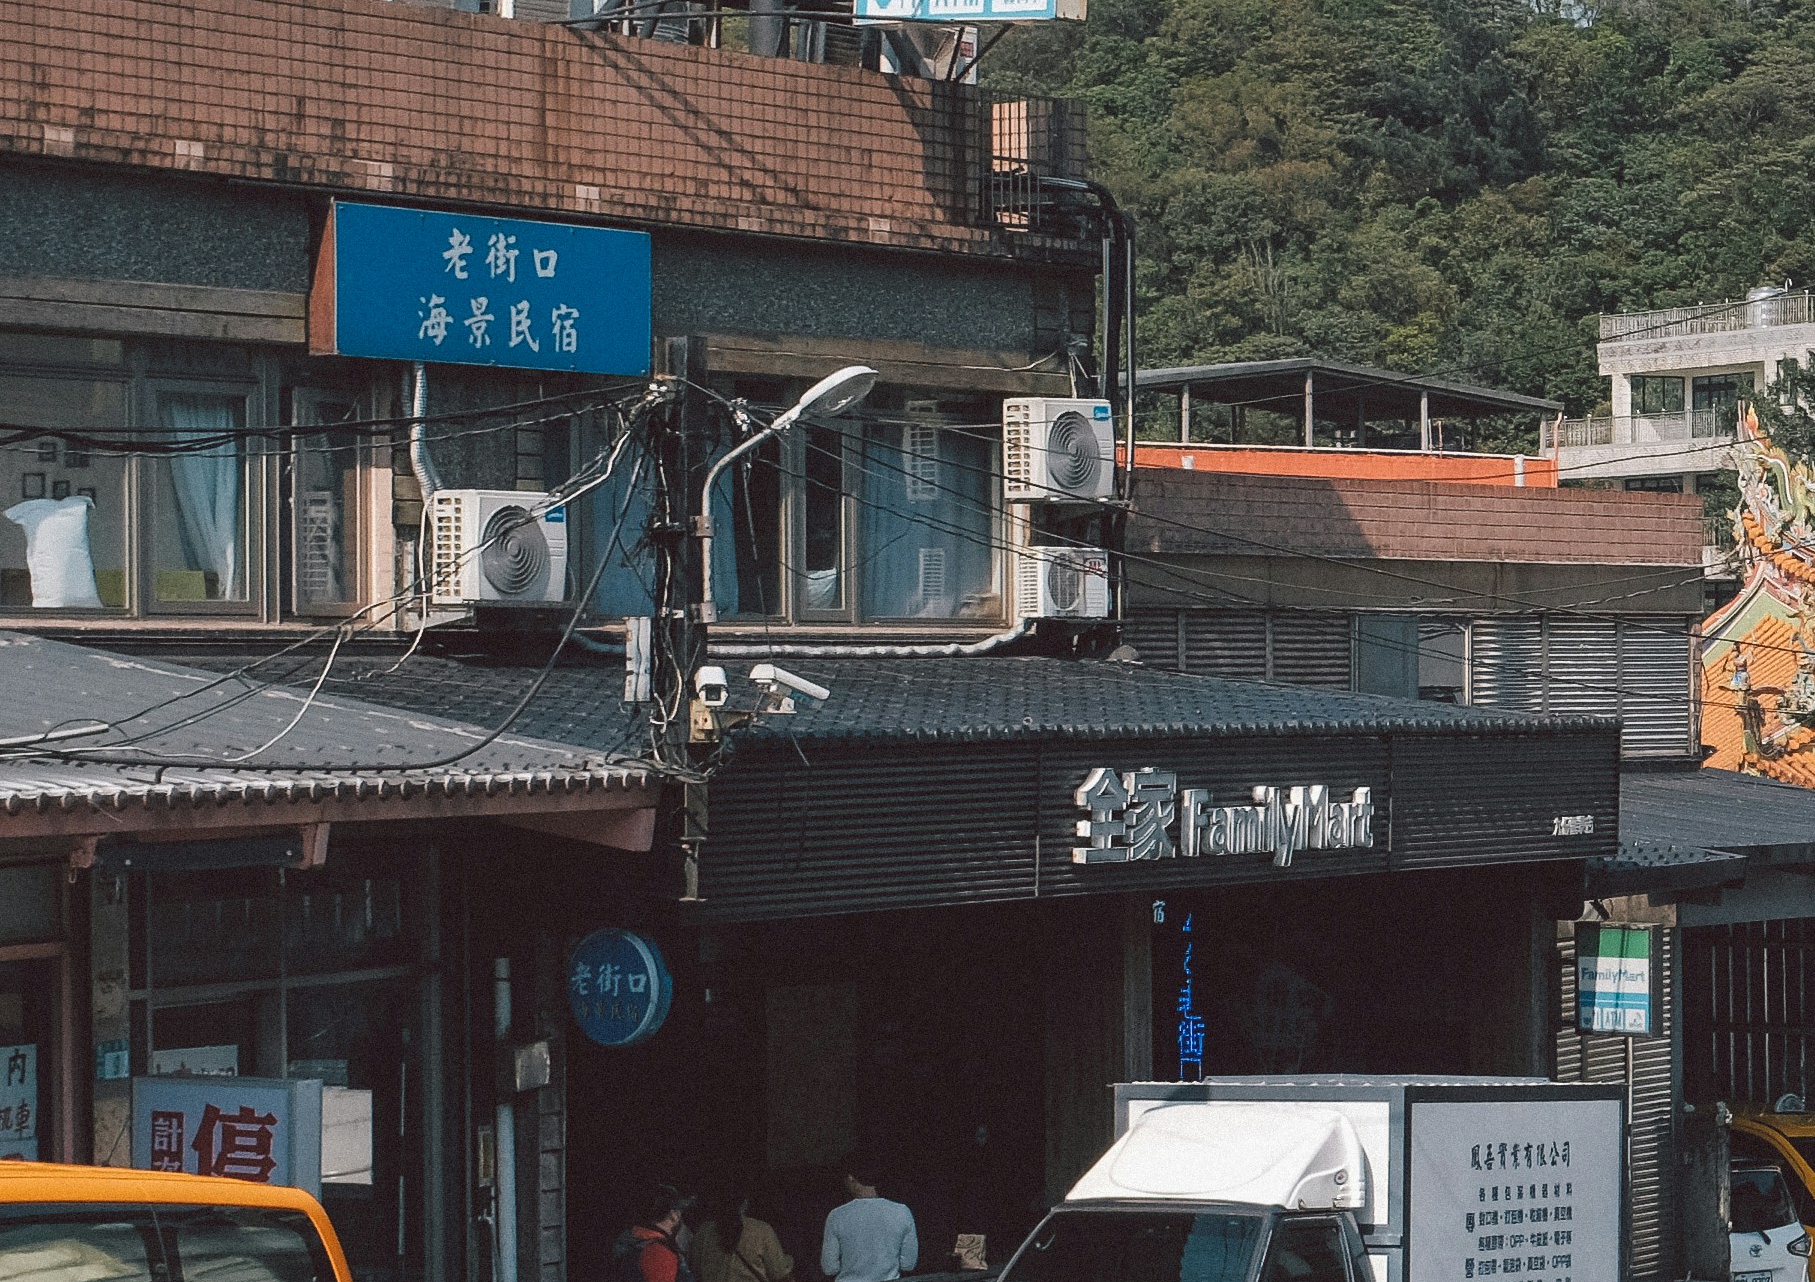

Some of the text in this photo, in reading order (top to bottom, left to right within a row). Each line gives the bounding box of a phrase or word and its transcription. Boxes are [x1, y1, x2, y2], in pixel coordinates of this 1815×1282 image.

[442, 228, 559, 283] 老街口
[417, 293, 579, 353] 海景民宿
[1073, 767, 1374, 867] 全家 FamilyMart
[571, 962, 648, 997] 老街口
[1581, 966, 1646, 983] FamilyMart
